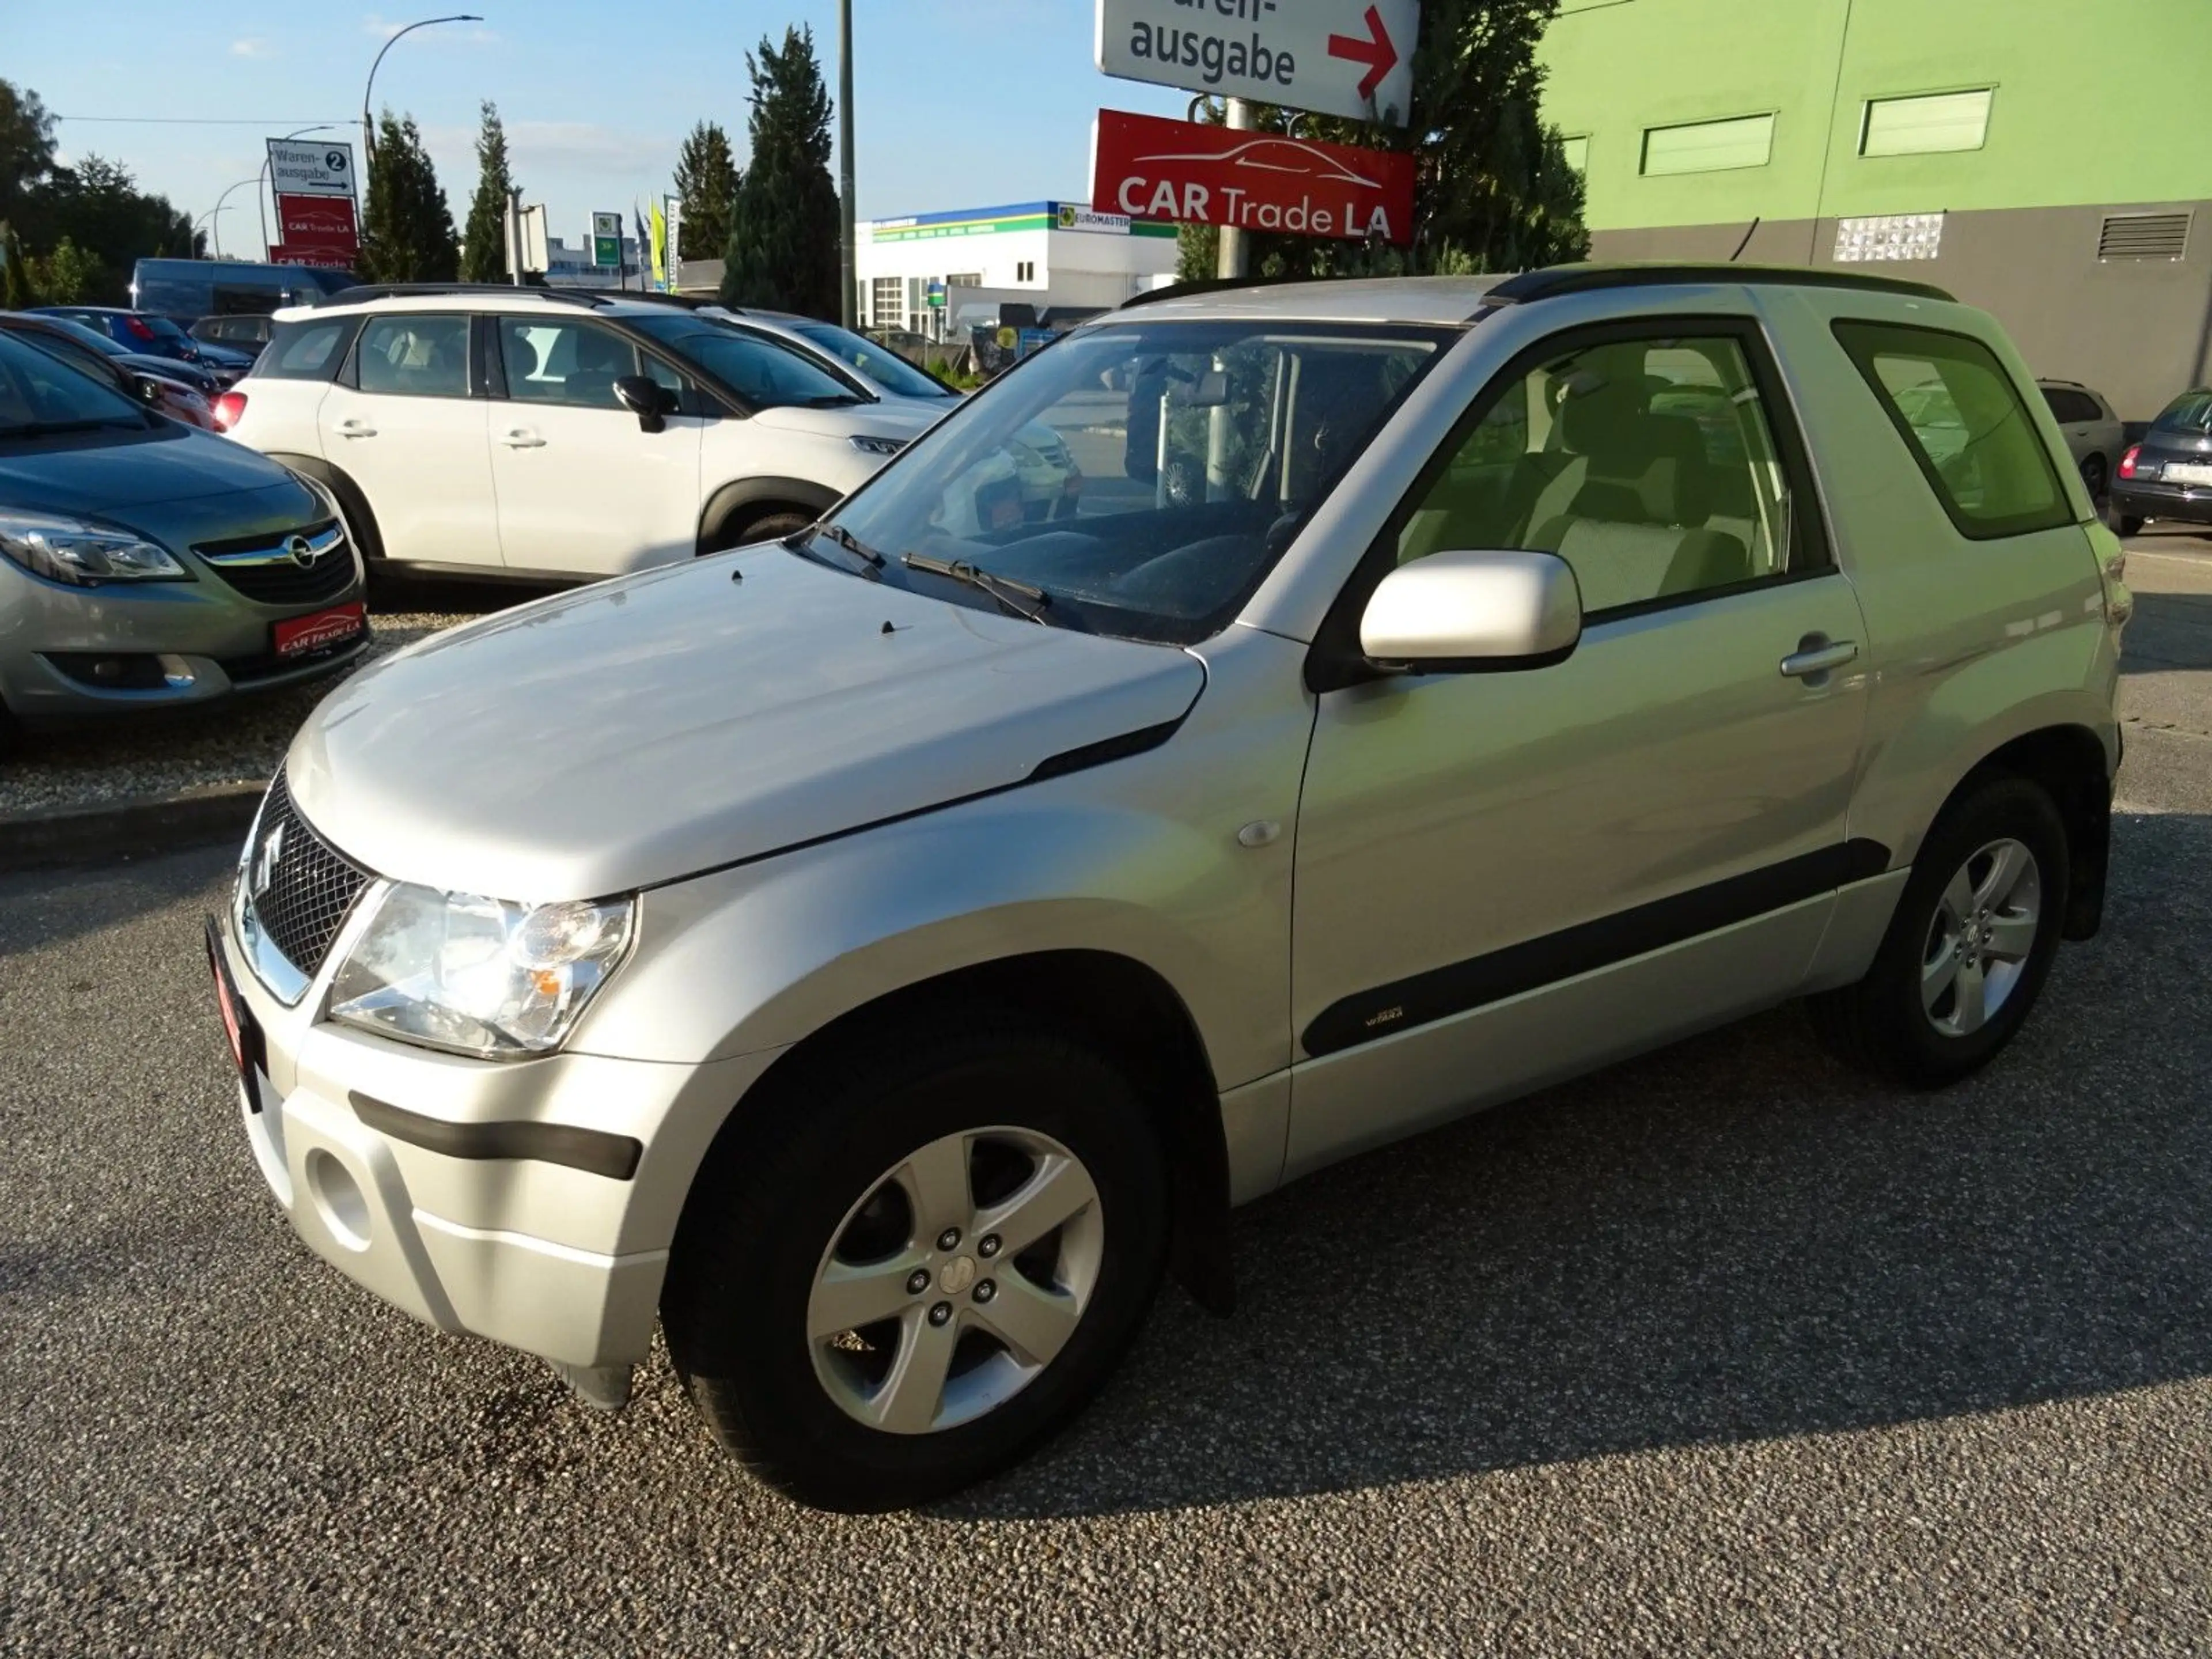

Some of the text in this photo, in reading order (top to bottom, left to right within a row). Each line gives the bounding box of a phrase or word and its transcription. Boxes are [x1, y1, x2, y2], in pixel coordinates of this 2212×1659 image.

[1130, 21, 1295, 85] ausgabe
[275, 150, 342, 169] Waren- 2
[277, 166, 329, 181] ausgabe
[1118, 176, 1392, 239] CAR Trade LA
[289, 222, 308, 231] CAR
[337, 225, 350, 233] LA
[1075, 213, 1130, 227] EUROMASTER
[281, 637, 308, 652] CAR
